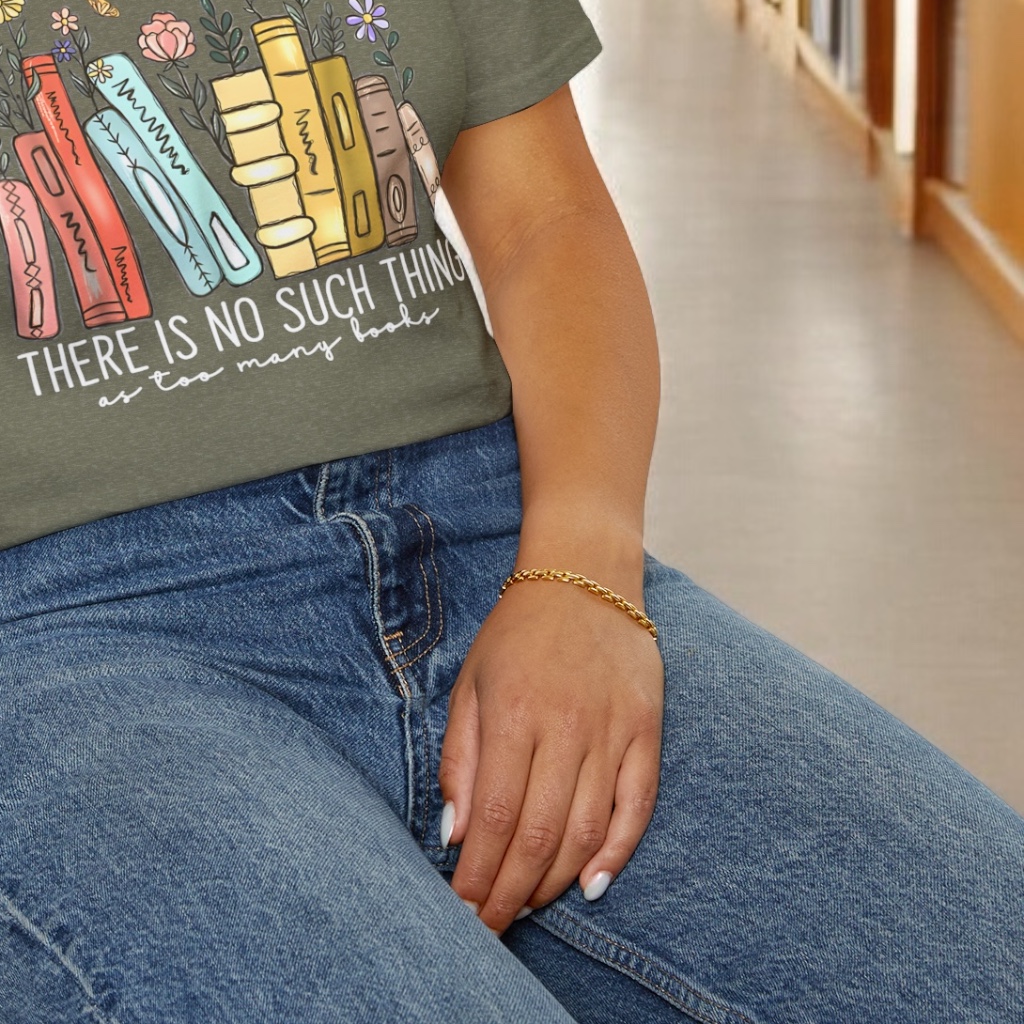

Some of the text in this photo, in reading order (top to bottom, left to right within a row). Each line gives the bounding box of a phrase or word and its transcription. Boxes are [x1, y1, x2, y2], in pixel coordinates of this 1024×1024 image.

[17, 327, 149, 397] THERE
[154, 315, 198, 365] IS
[204, 297, 265, 352] NO
[275, 263, 376, 334] SUCH
[98, 303, 440, 408] as too many books
